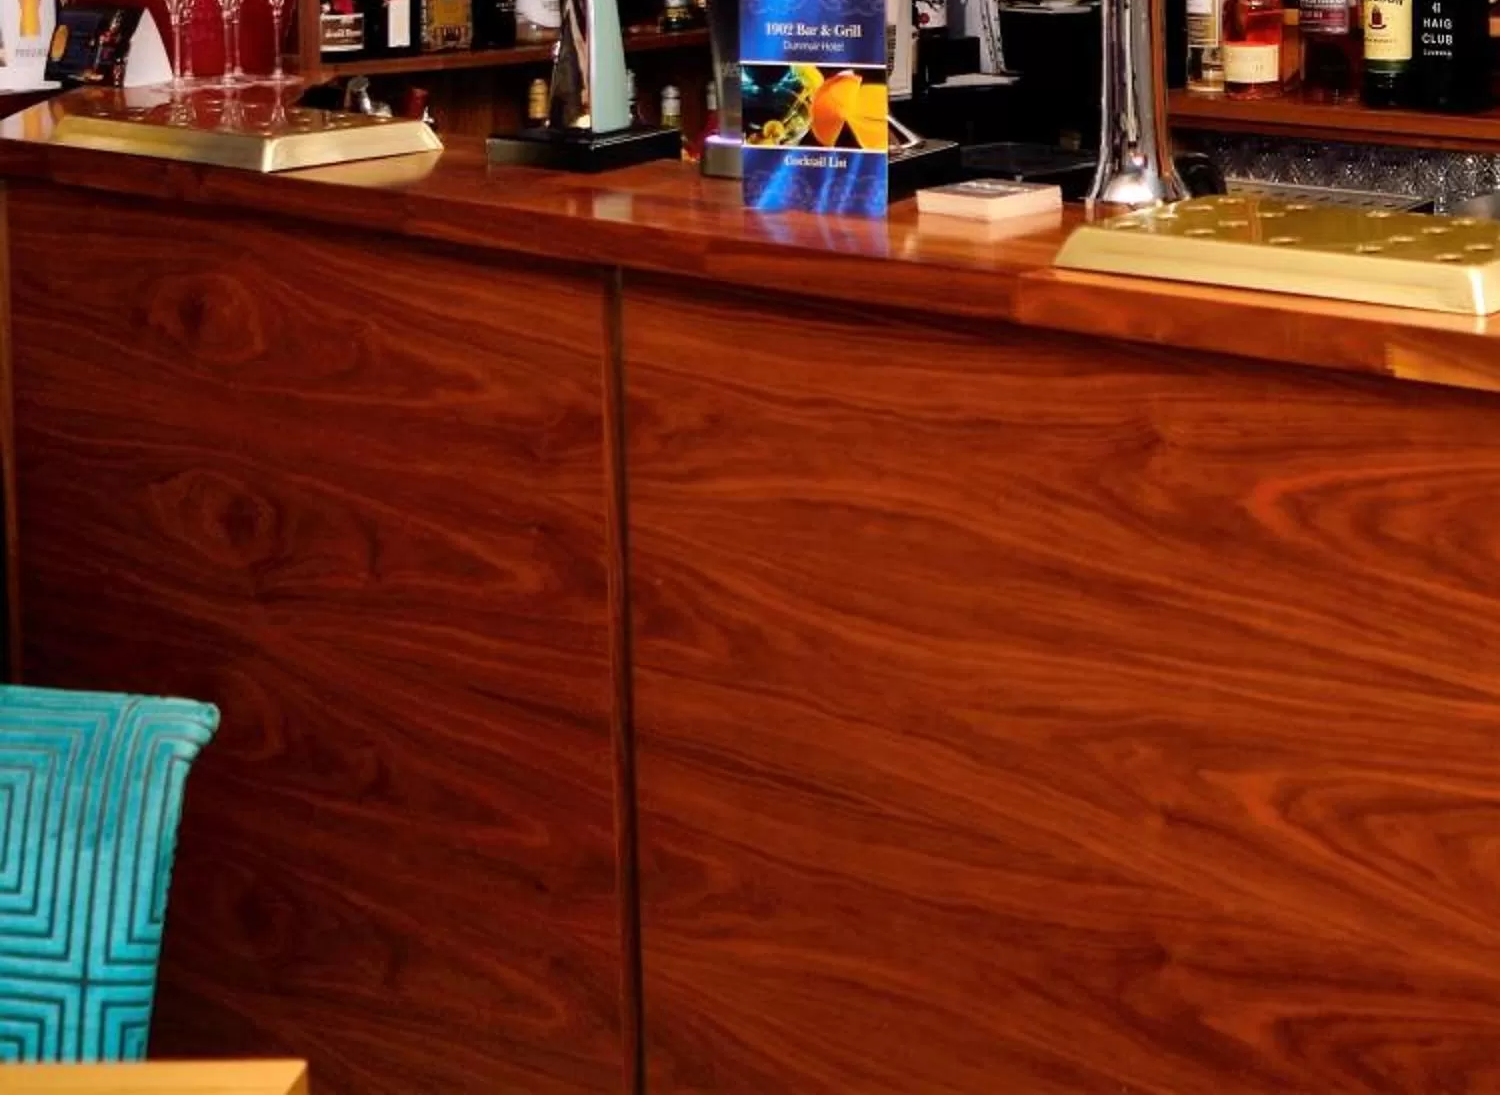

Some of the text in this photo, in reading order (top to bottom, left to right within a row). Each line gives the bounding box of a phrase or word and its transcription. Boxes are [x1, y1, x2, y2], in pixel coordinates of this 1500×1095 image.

[797, 22, 819, 37] Bar
[821, 24, 832, 37] &
[834, 23, 862, 38] Grill
[1422, 17, 1453, 31] HAIG
[1421, 33, 1454, 46] CLUB
[821, 41, 845, 53] Hotel
[783, 153, 848, 168] Cocktail List
